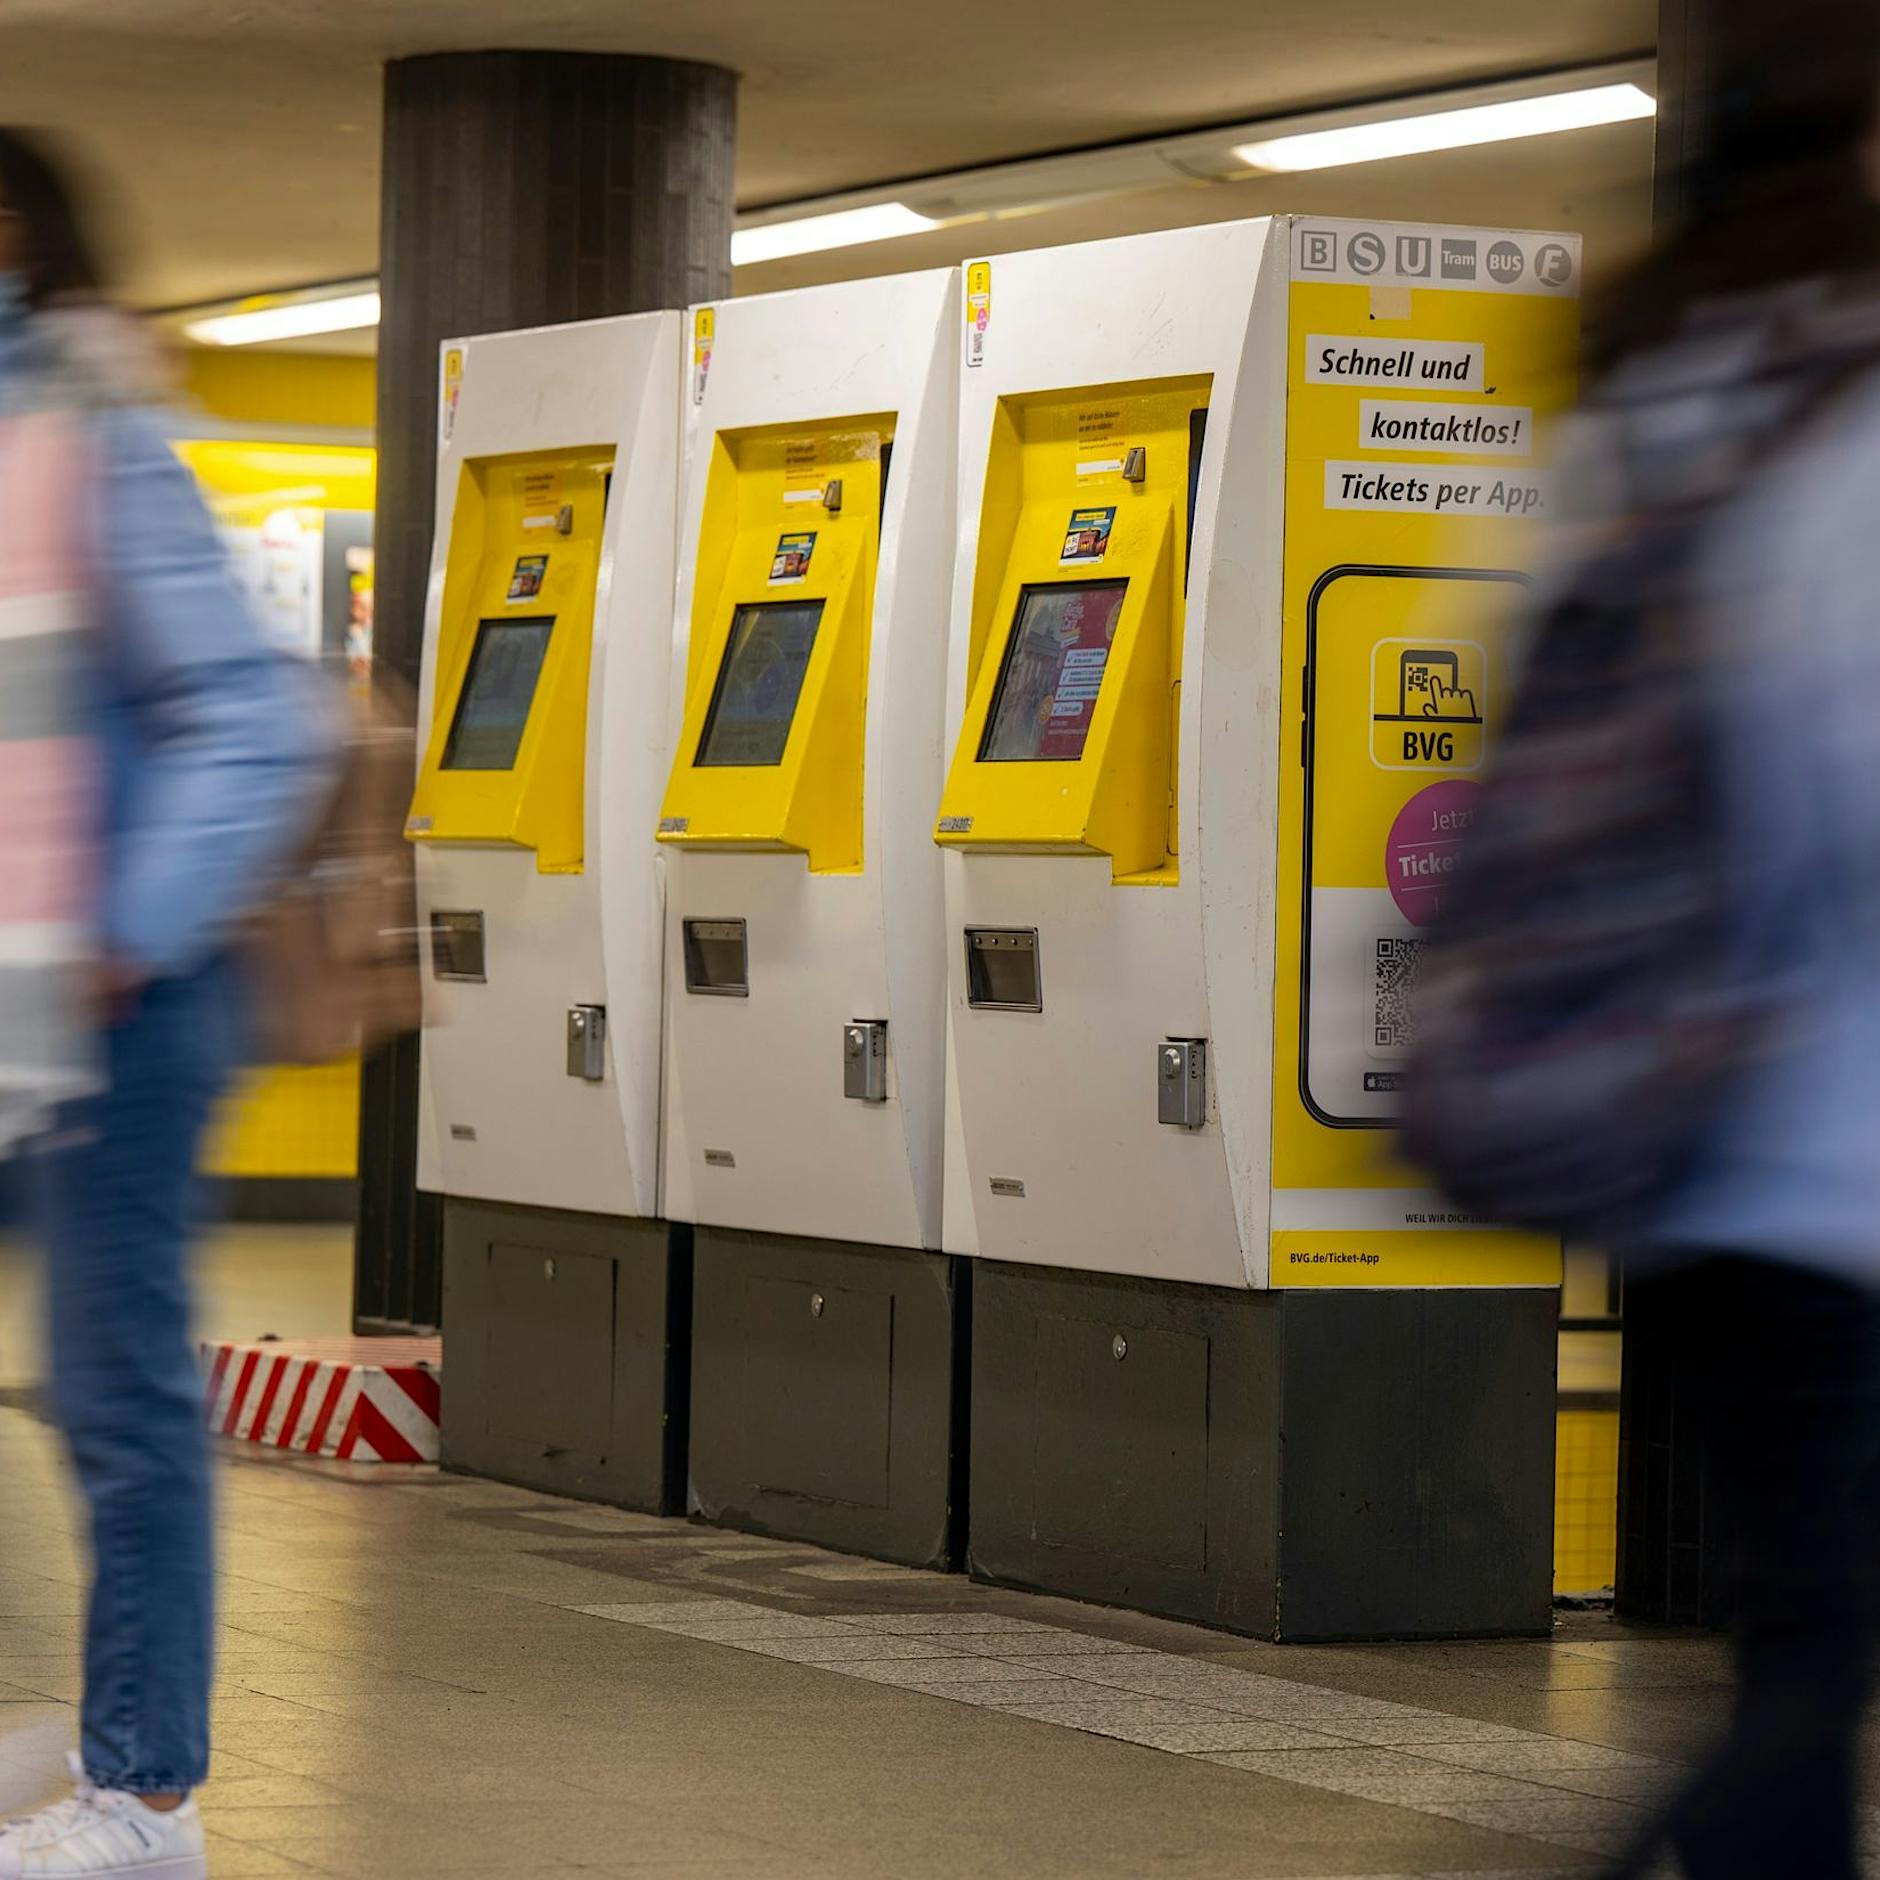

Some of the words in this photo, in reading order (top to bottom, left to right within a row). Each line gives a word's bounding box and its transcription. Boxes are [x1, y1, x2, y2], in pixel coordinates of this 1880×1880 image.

[1310, 237, 1328, 265] B
[1351, 233, 1382, 275] S
[1400, 240, 1428, 275] U
[1443, 250, 1475, 266] Tram
[1489, 254, 1522, 271] BUS
[1319, 348, 1415, 378] Schnell
[1421, 354, 1471, 380] und
[1370, 411, 1521, 444] kontaktlos!
[1341, 473, 1429, 502] Tickets
[1435, 483, 1481, 510] per
[1487, 481, 1545, 513] App.
[1403, 732, 1454, 761] BVG
[1405, 1214, 1427, 1224] WEIL
[1428, 1214, 1446, 1224] WIR
[1447, 1214, 1469, 1224] DICH
[1290, 1253, 1380, 1265] BVG.de/Ticket-App
